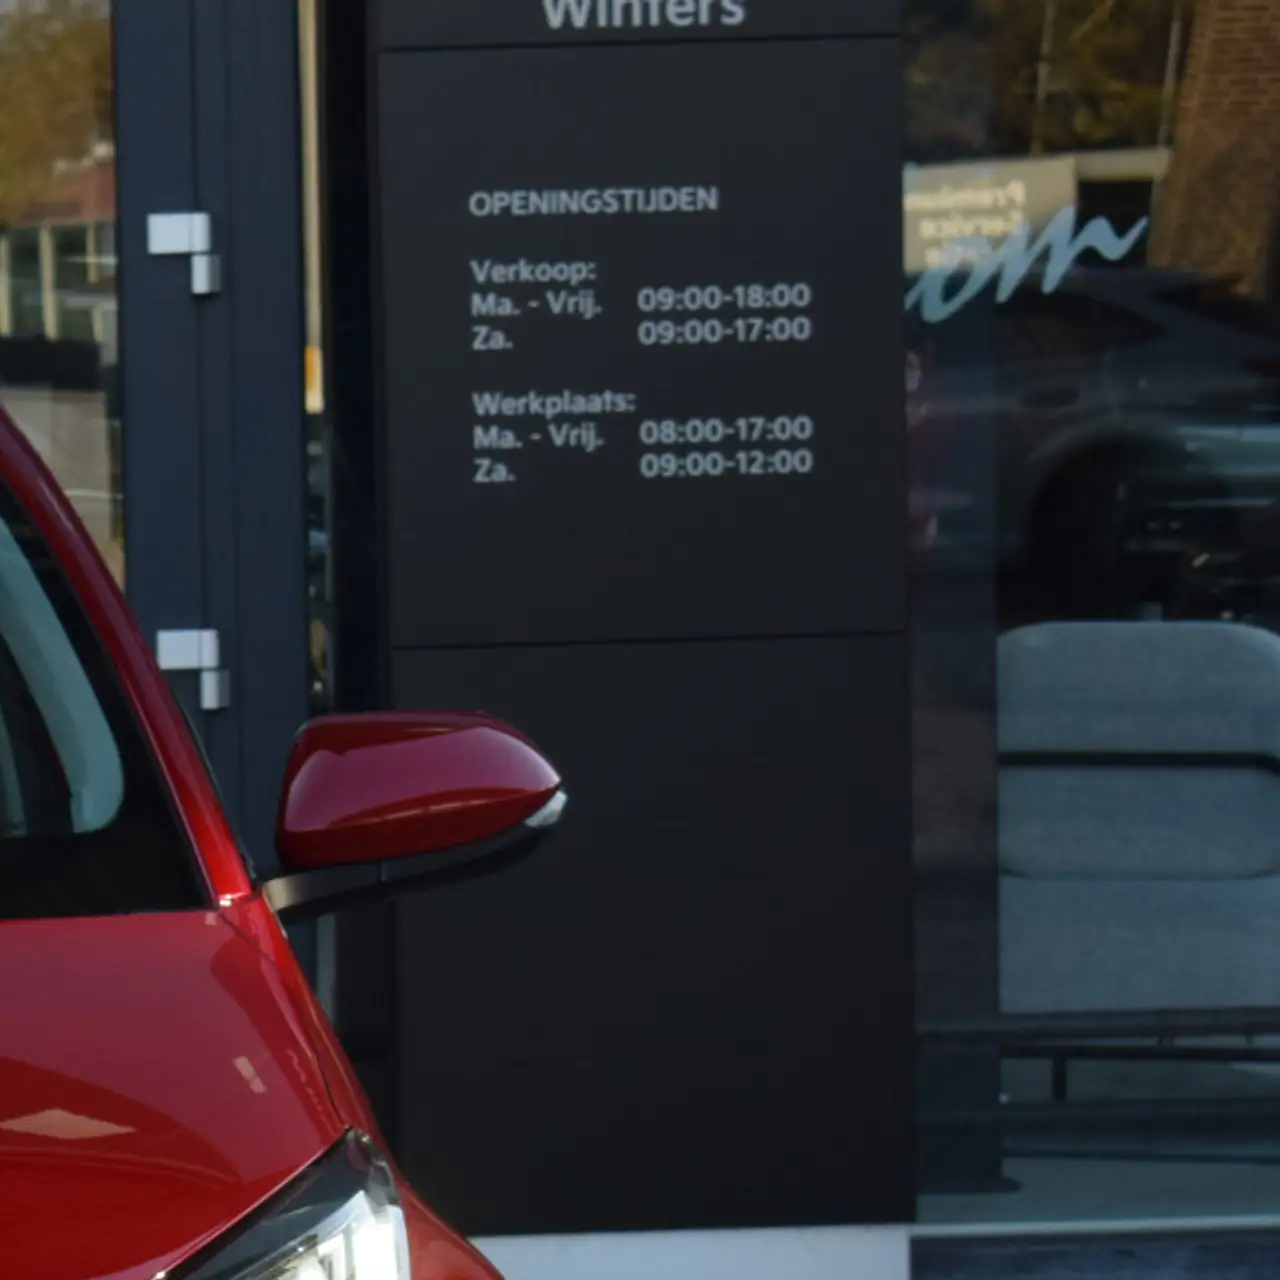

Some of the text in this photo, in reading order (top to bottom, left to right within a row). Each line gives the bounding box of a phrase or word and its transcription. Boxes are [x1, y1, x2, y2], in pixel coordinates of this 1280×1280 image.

[541, 0, 747, 30] Winters
[468, 186, 719, 216] OPENINGSTIJDEN
[469, 258, 597, 286] Verkoop:
[470, 293, 521, 317] Ma.
[545, 288, 603, 319] Vrij.
[637, 283, 812, 312] 09:00-18:00
[471, 316, 812, 350] Za. 09:00-17:00
[471, 390, 637, 420] Werkplaats:
[473, 425, 523, 449] Ma.
[547, 421, 604, 452] Vrij.
[639, 416, 814, 445] 08:00-17:00
[473, 449, 814, 483] Za. 09:00-12:00
